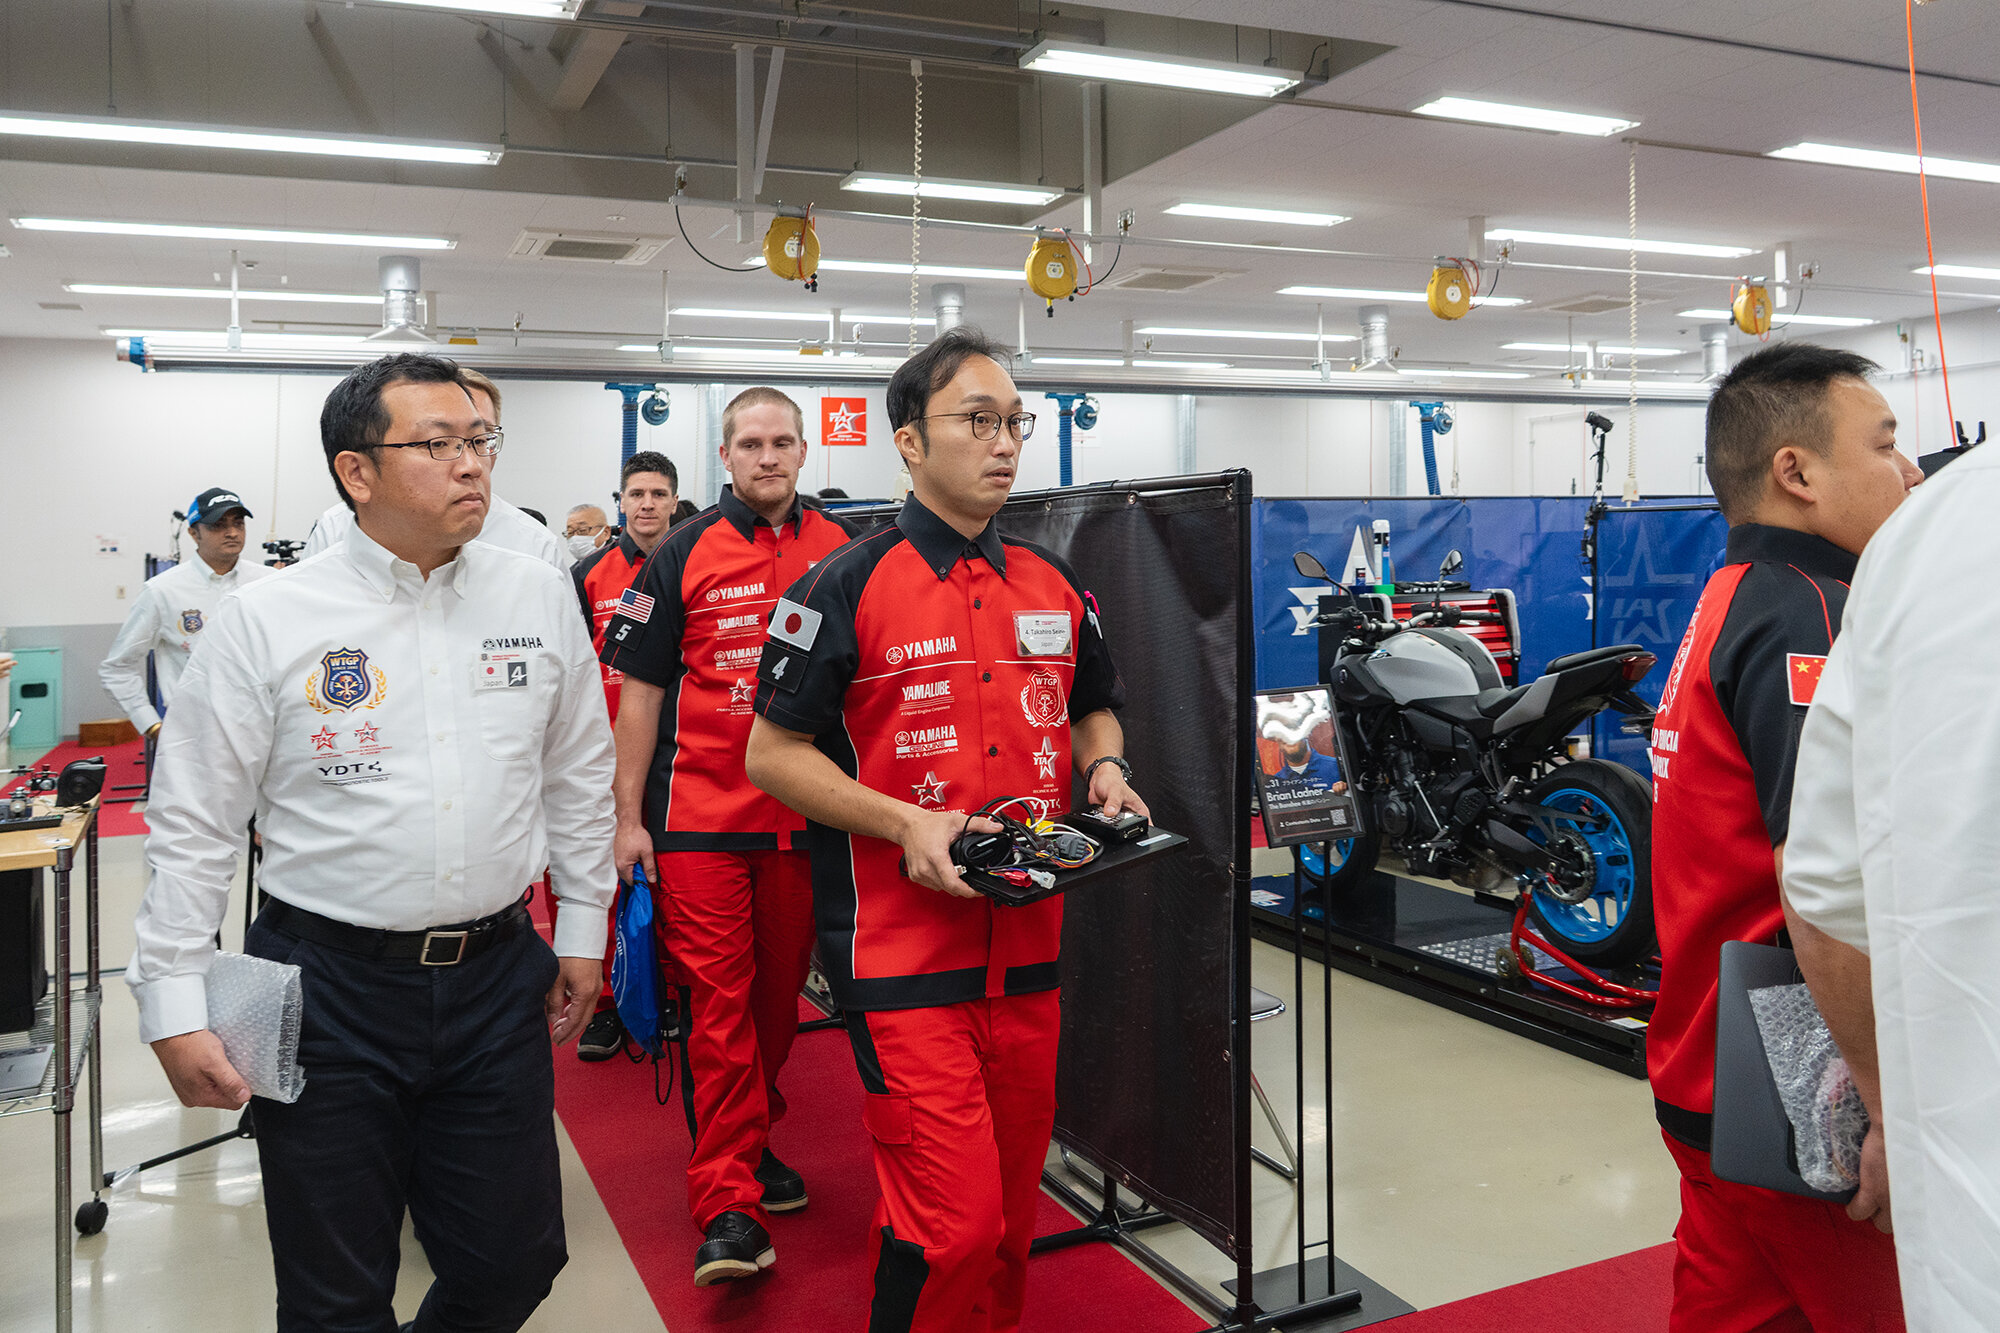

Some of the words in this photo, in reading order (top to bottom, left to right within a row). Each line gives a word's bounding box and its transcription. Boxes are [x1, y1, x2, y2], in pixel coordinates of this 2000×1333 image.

[720, 583, 766, 600] YAMAHA
[604, 598, 620, 608] YAM
[717, 614, 760, 630] YAMALUBE
[615, 624, 632, 641] 5
[496, 637, 544, 649] YAMAHA
[904, 636, 957, 660] YAMAHA
[726, 646, 763, 660] YAMAHA
[330, 656, 360, 667] WTGP
[772, 656, 790, 680] 4
[1036, 677, 1058, 686] WTGP
[902, 680, 951, 701] YAMALUBE
[911, 725, 957, 744] YAMAHA
[922, 747, 959, 757] Accessories
[1033, 756, 1048, 765] YTA
[318, 763, 365, 776] YDT
[1266, 790, 1292, 802] Brian
[1291, 786, 1324, 798] Ladner
